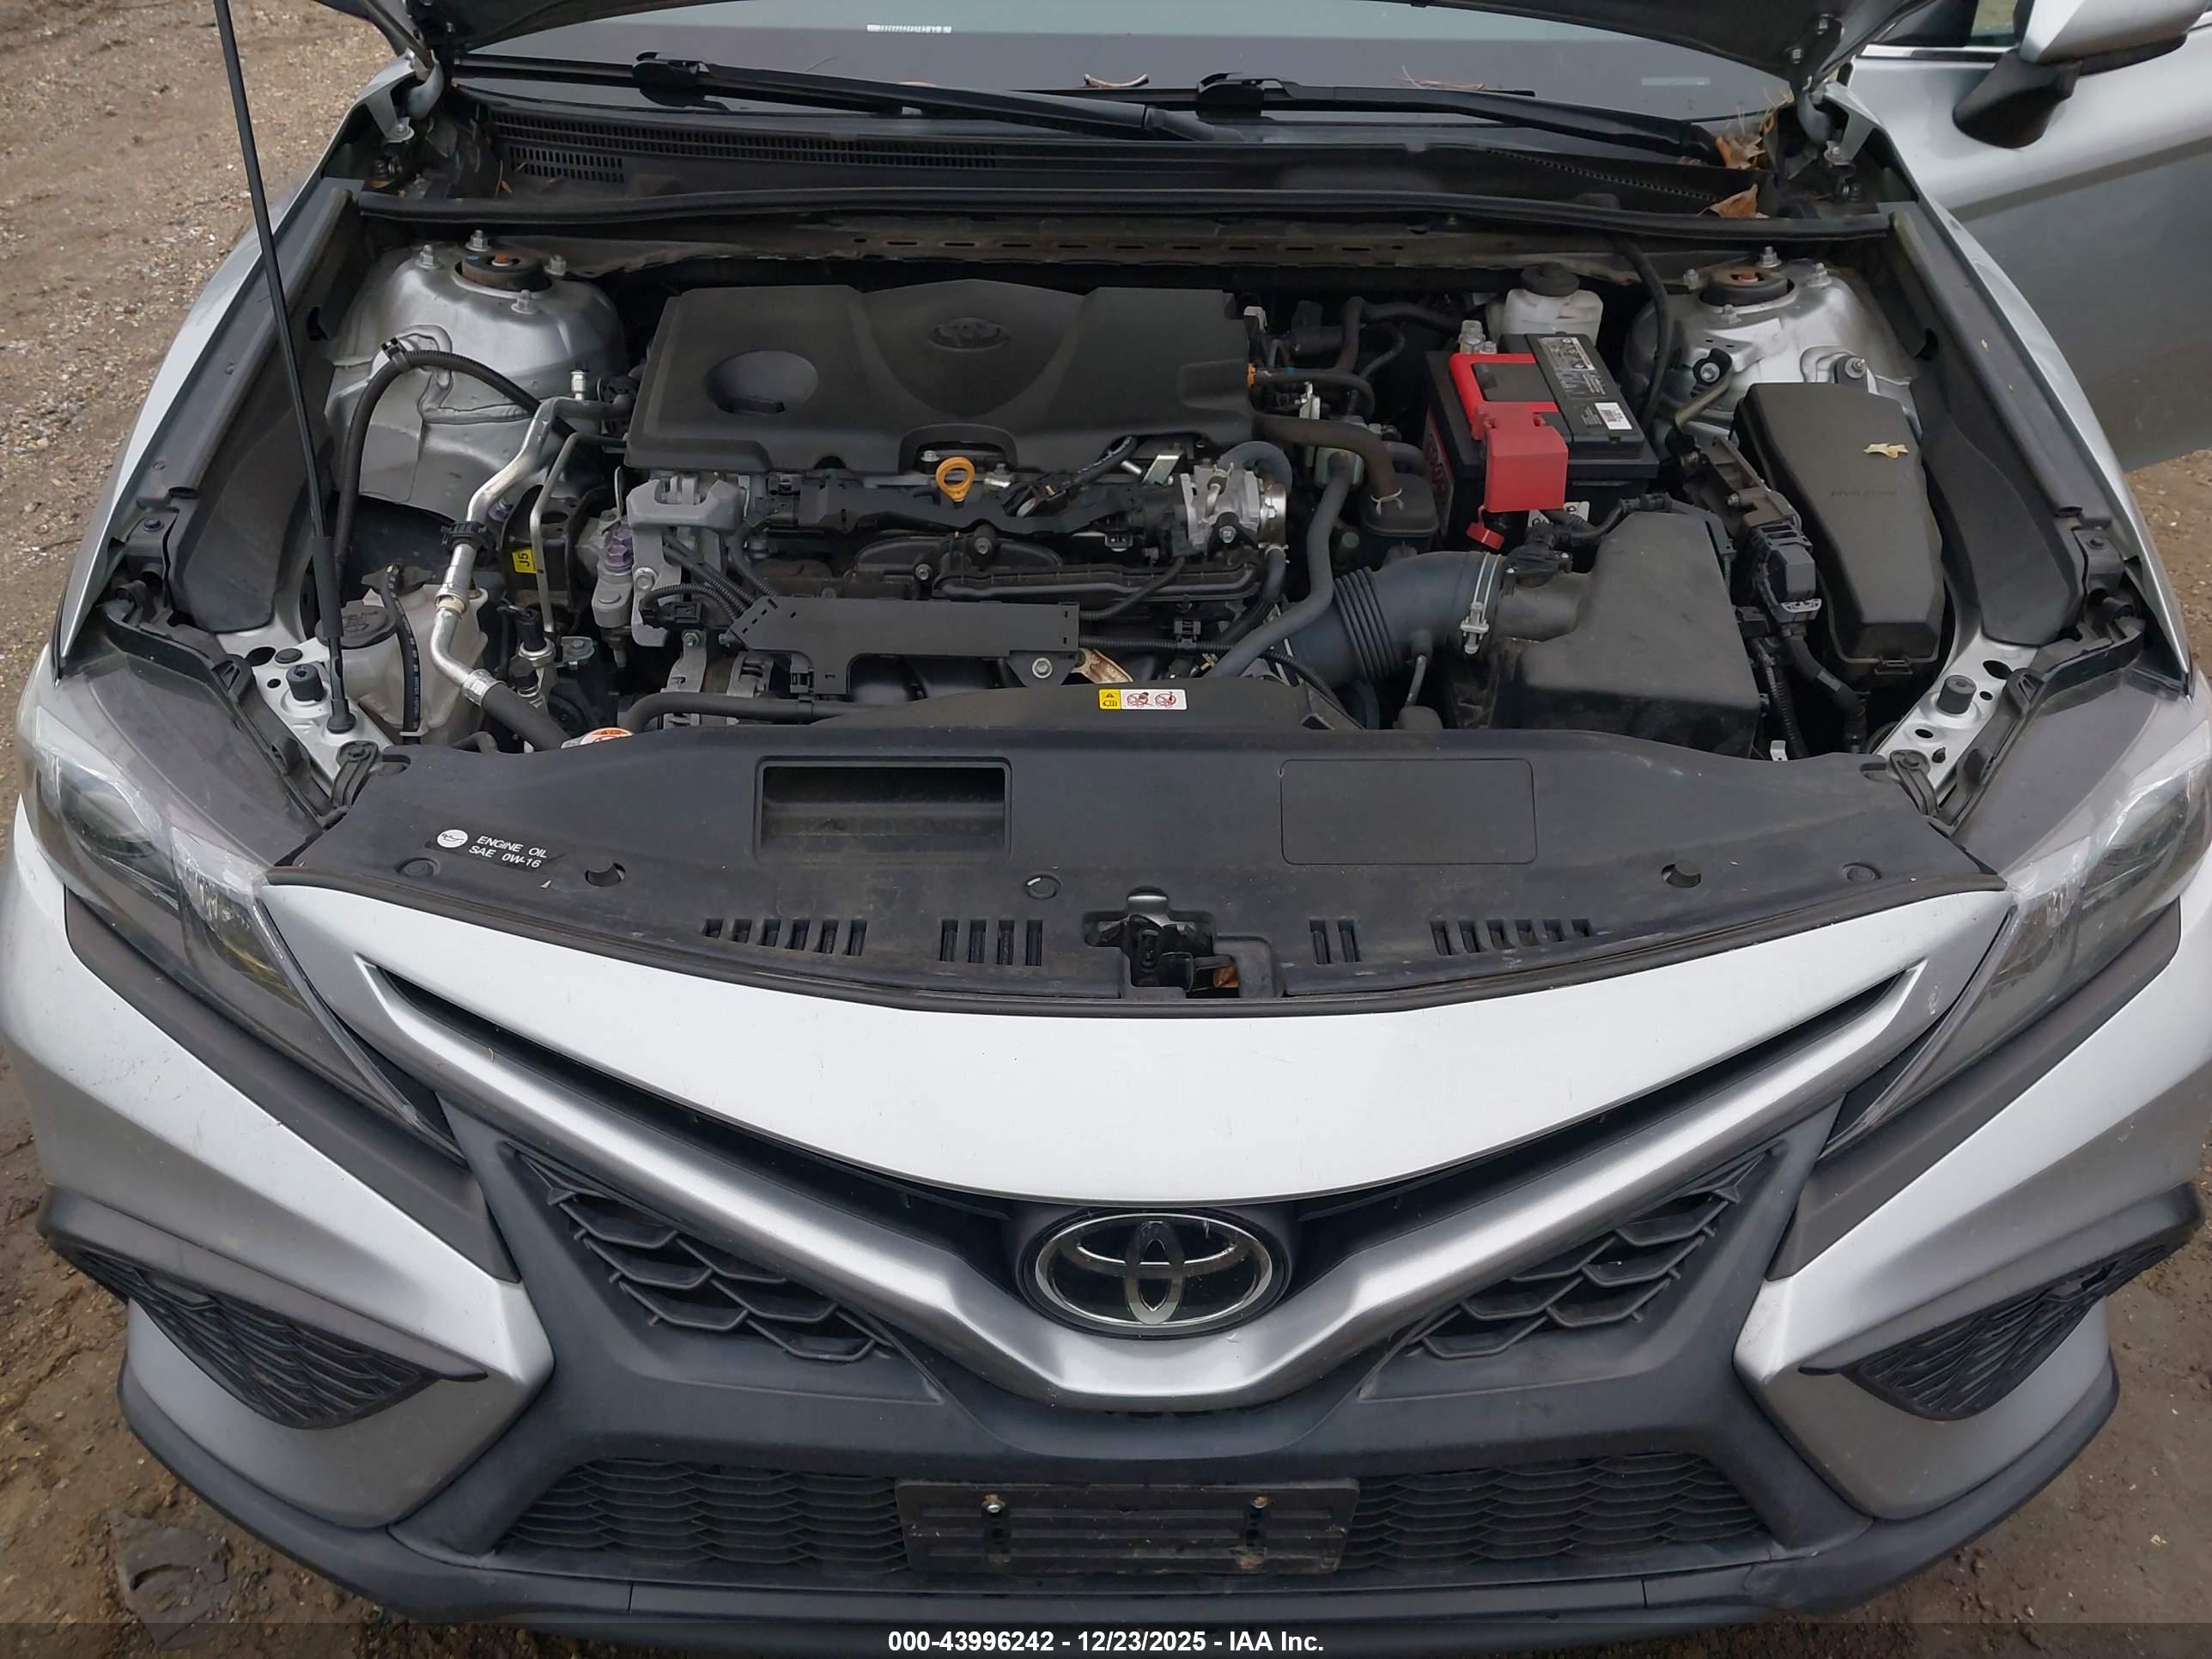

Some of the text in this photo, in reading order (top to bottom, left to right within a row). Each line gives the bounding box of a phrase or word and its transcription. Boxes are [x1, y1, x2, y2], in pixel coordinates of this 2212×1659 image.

[518, 553, 530, 567] J5
[469, 845, 542, 868] SAE 0W-16
[477, 836, 548, 859] ENGINE OIL
